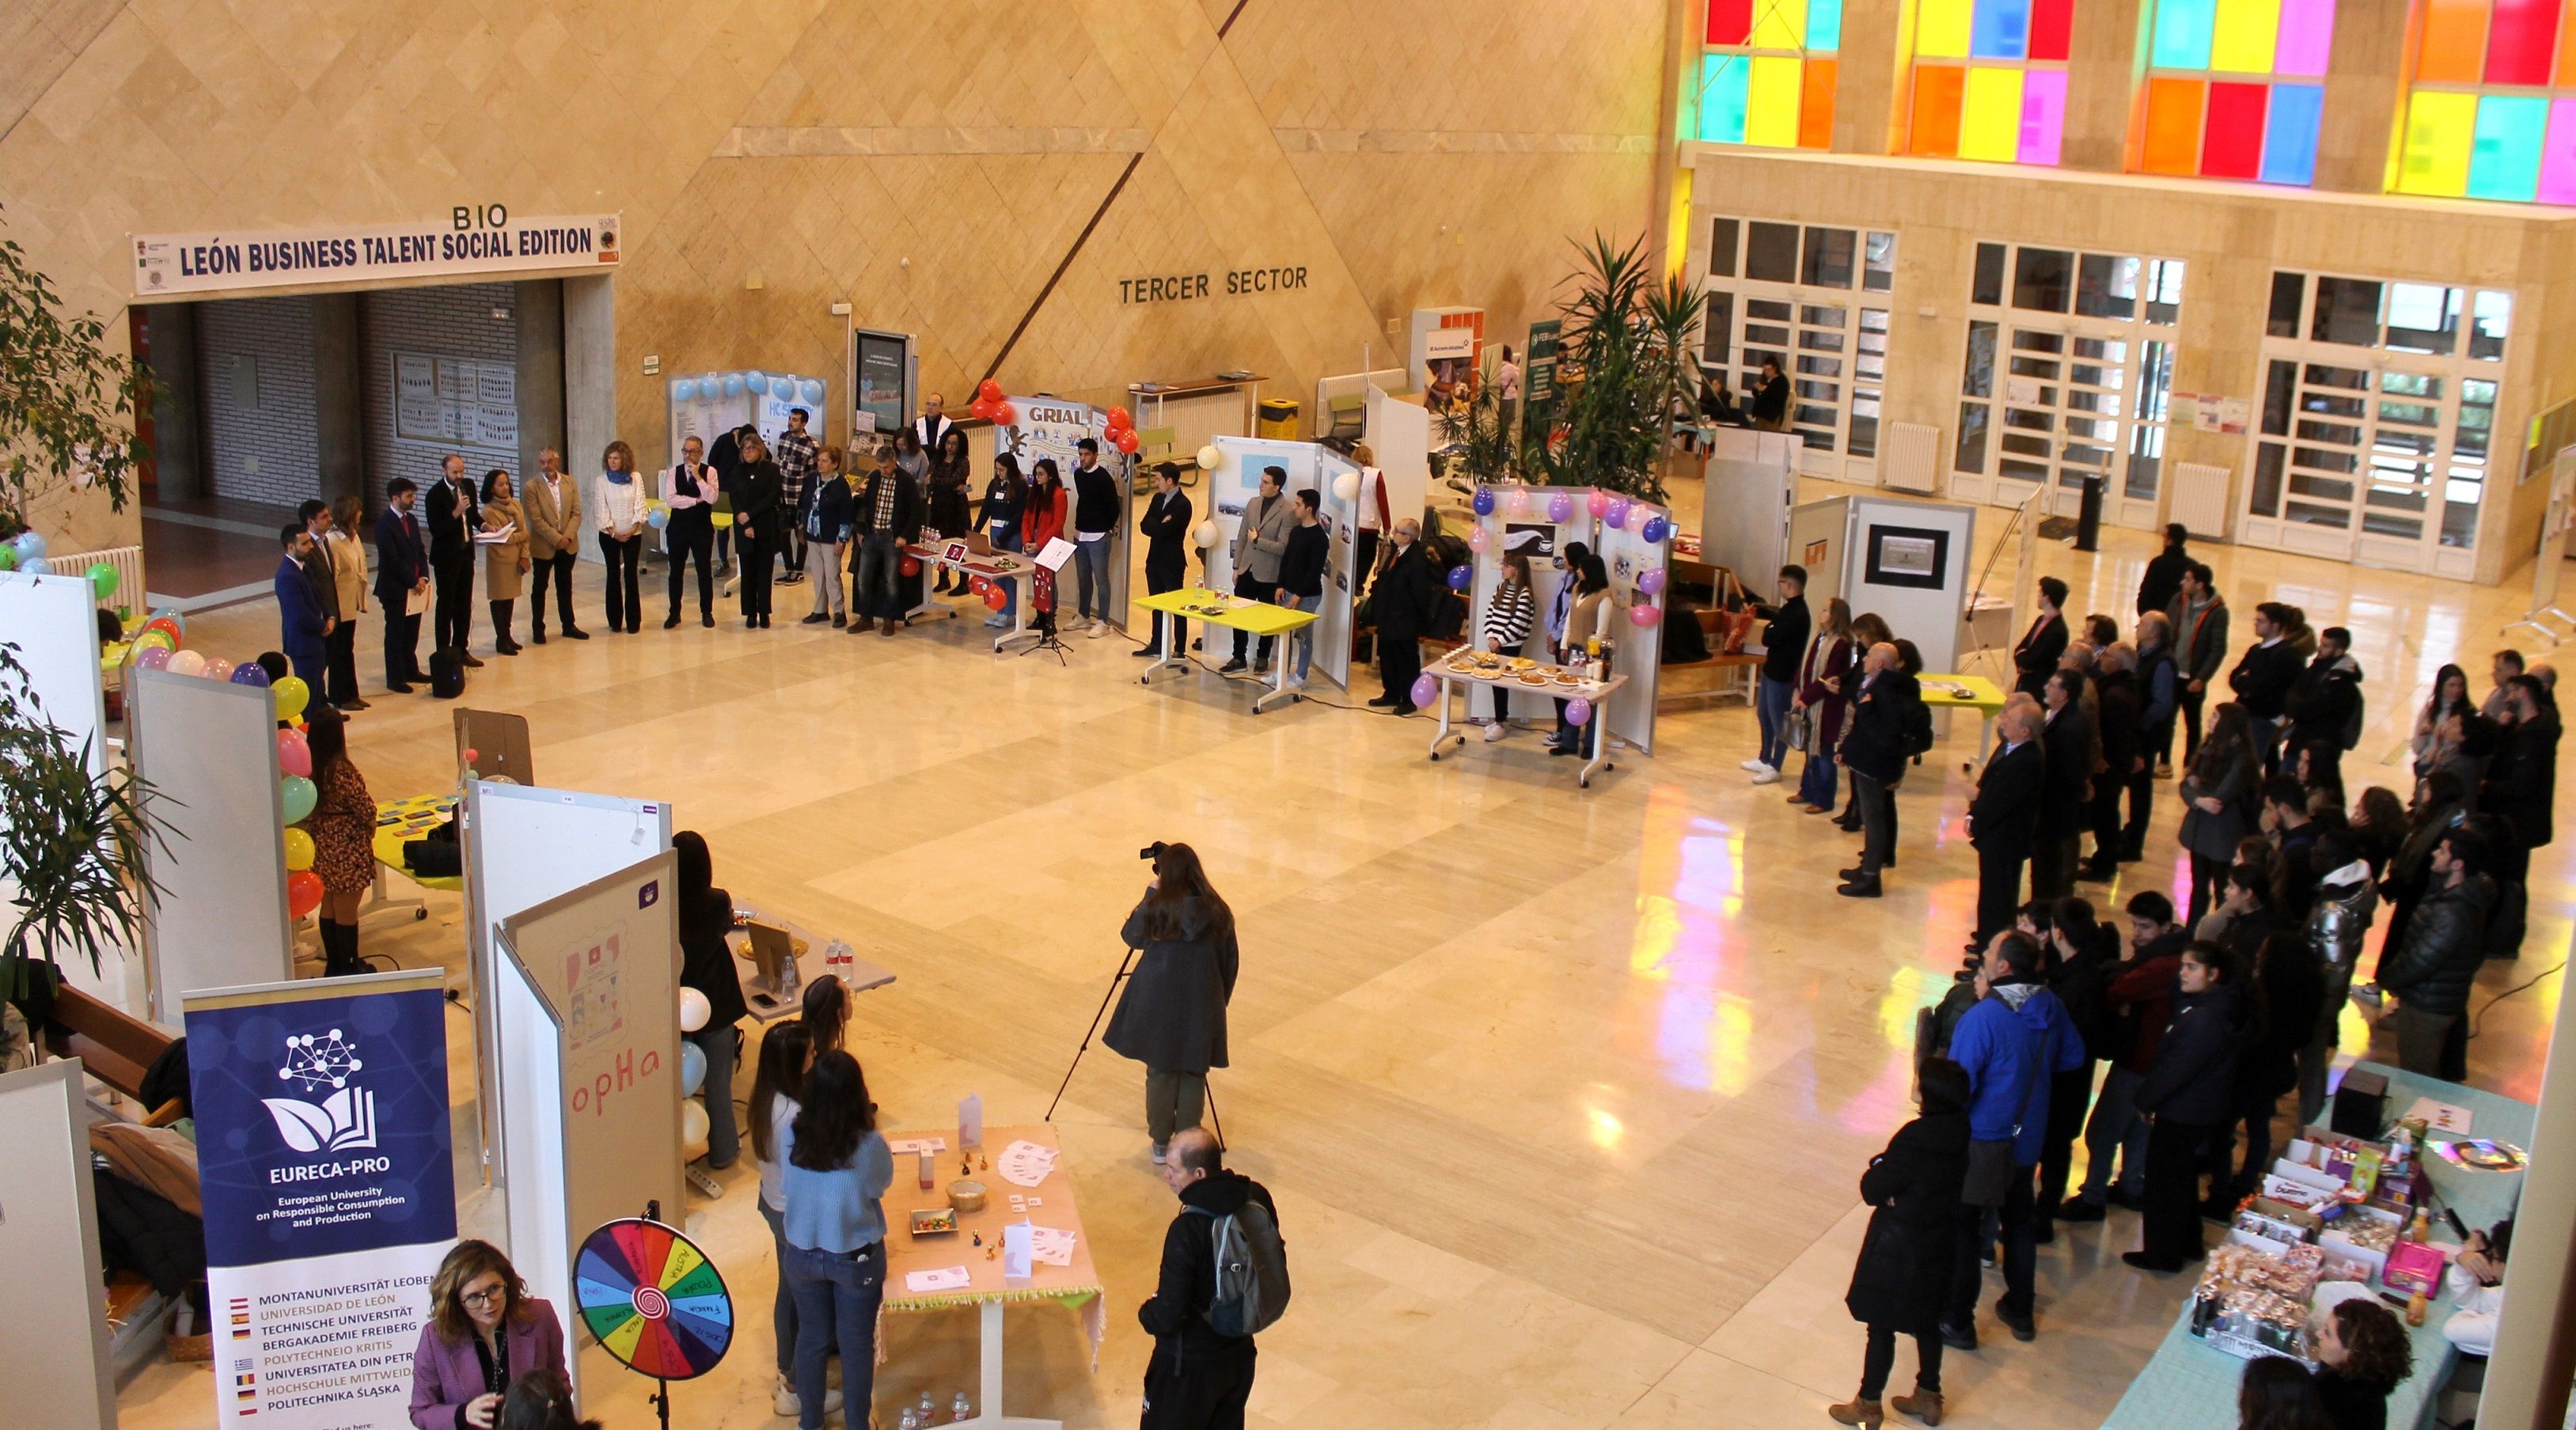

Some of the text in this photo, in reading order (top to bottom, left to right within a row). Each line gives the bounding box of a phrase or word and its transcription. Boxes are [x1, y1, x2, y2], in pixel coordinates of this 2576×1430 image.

[453, 203, 507, 231] BIO
[180, 228, 591, 276] LEÓN BUSINESS TALENT SOCIAL EDITION
[1120, 267, 1307, 304] TERCER SECTOR
[1029, 407, 1088, 425] GRIAL
[270, 1156, 391, 1184] EURECA-PRO
[273, 1203, 336, 1219] Responsible
[336, 1195, 406, 1213] Consumption
[278, 1187, 383, 1207] European University
[292, 1211, 372, 1227] and Production
[670, 1248, 691, 1279] AUSTRIA
[259, 1280, 390, 1306] MONTANUNIVERSITÄT
[260, 1294, 396, 1321] UNIVERSIDAD DE LEÓN
[261, 1306, 414, 1336] TECHNISCHE UNIVERSITÄT
[262, 1322, 417, 1351] BERGAKADEMIE FREIBERG
[264, 1340, 393, 1366] POLYTECHNEIO KRITIS
[265, 1352, 414, 1381] UNIVERSITATEA DIN PETR
[267, 1376, 347, 1396] HOCHSCHULE
[267, 1383, 400, 1411] POLITECHNIKA ŚLĄSKA
